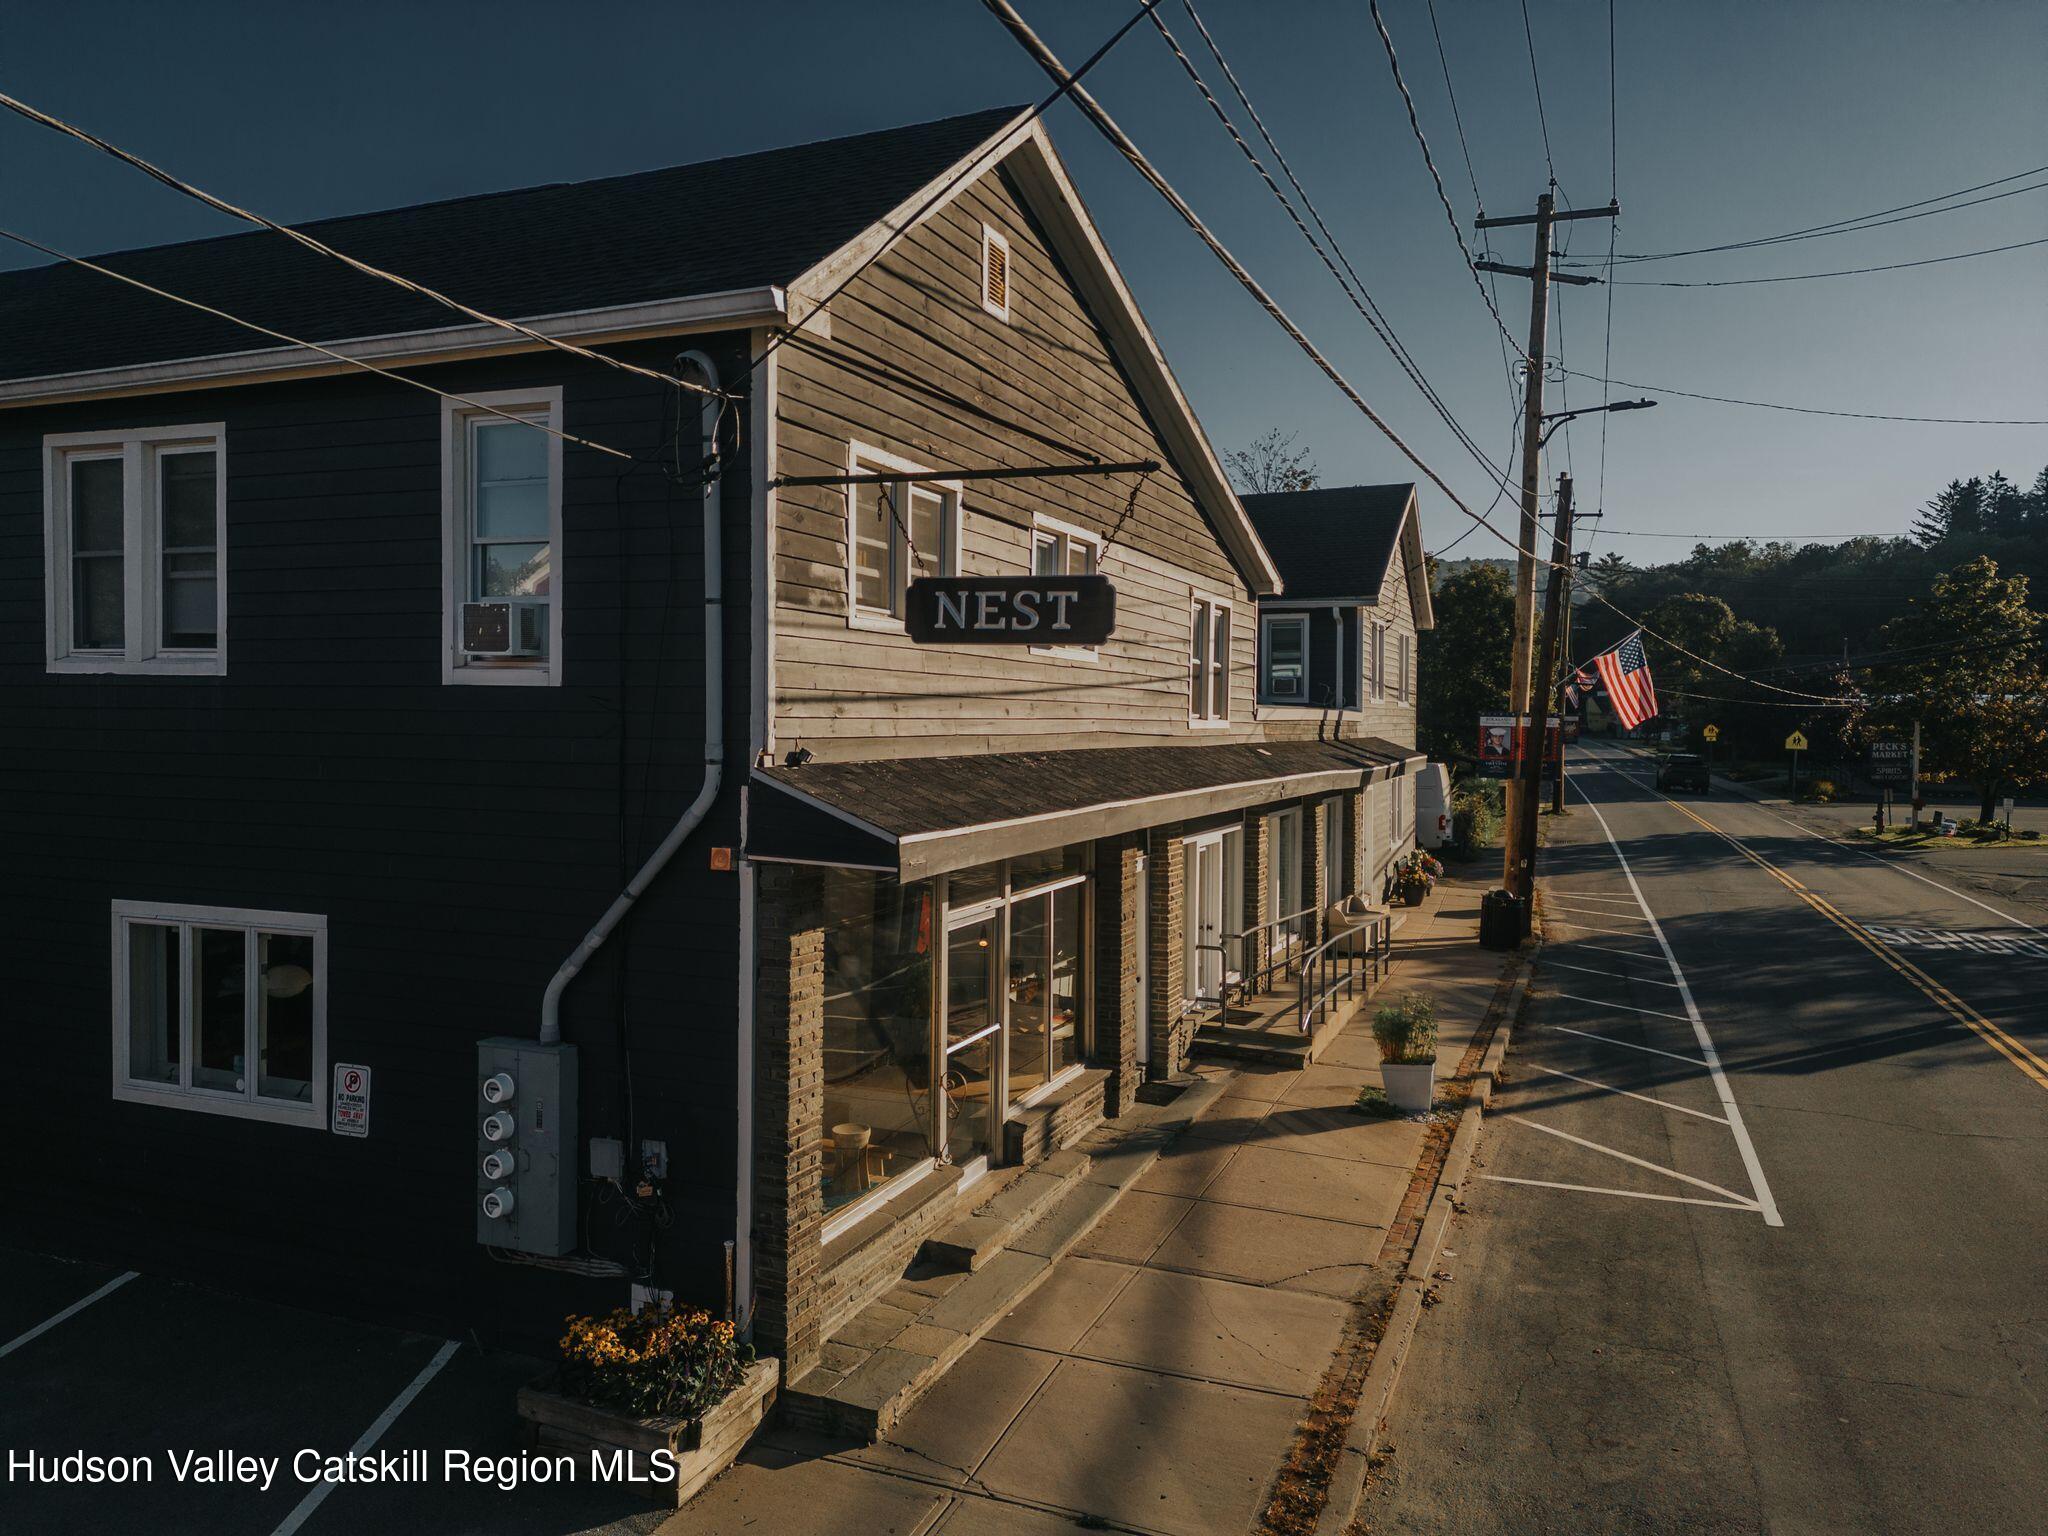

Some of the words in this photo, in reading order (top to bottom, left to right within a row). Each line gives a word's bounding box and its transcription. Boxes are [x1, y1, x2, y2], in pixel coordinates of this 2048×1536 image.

[934, 590, 1079, 631] NEST
[1871, 751, 1908, 759] MARKET
[346, 1094, 365, 1104] PARKING
